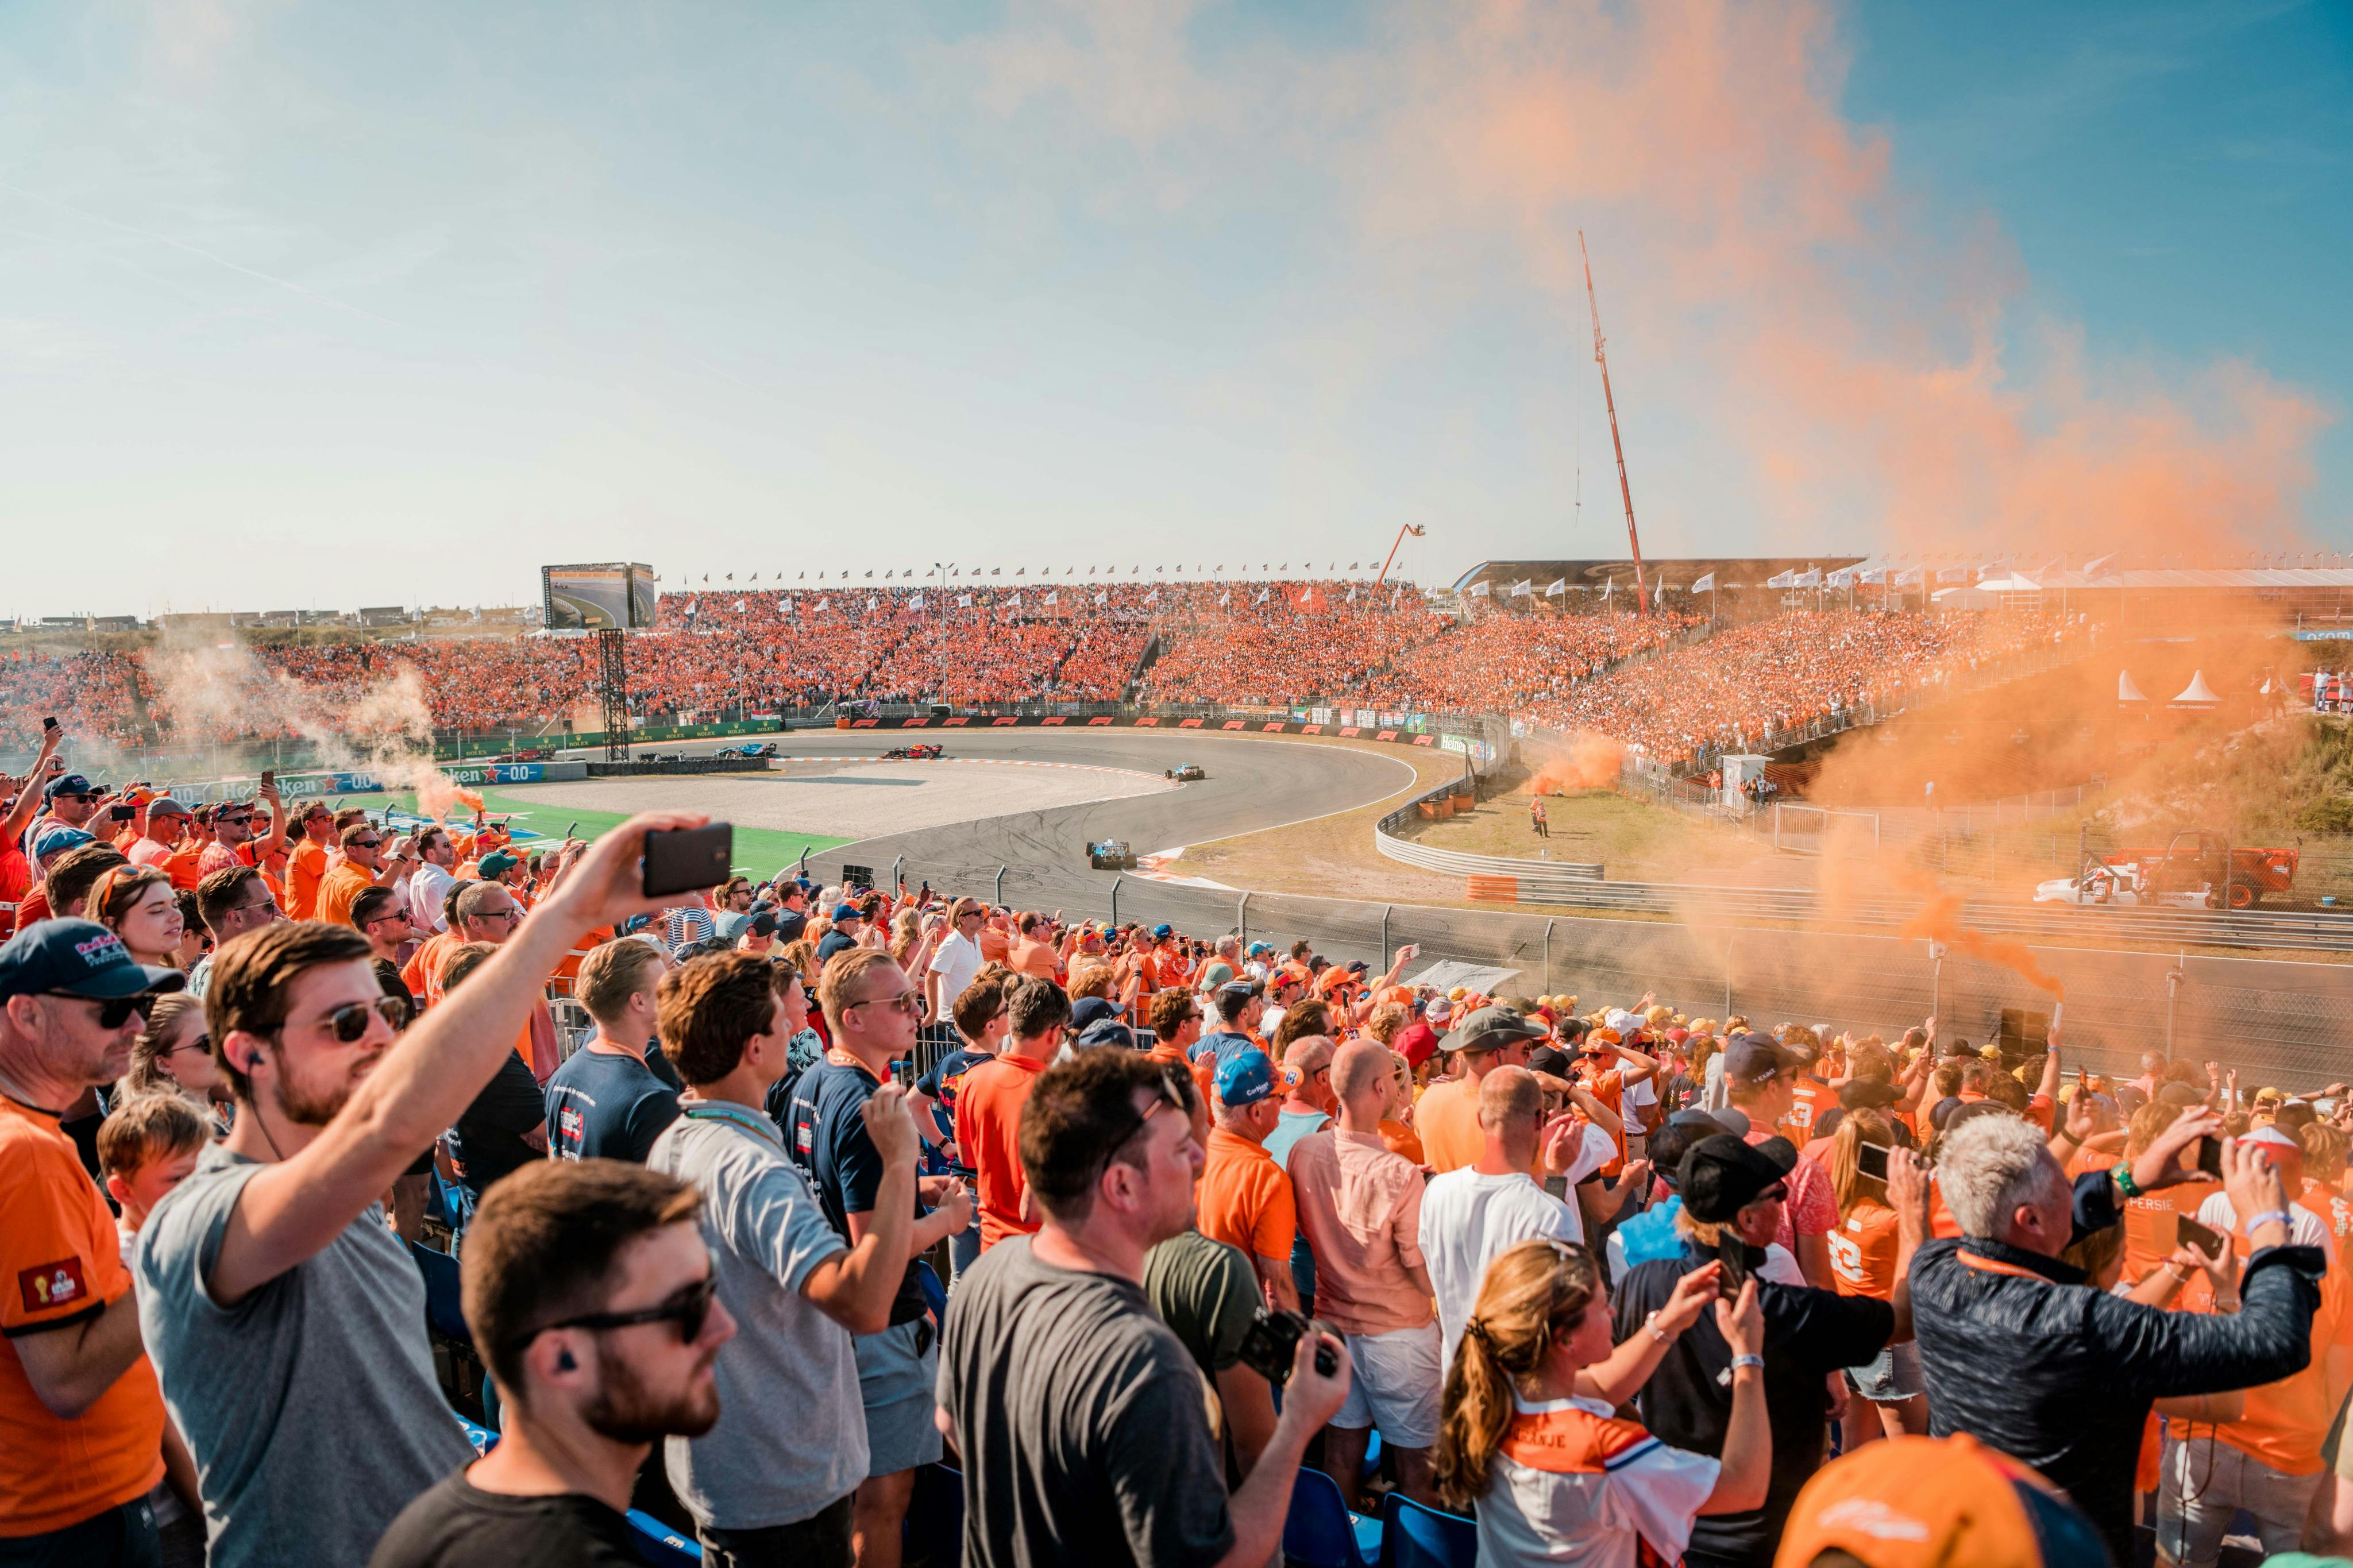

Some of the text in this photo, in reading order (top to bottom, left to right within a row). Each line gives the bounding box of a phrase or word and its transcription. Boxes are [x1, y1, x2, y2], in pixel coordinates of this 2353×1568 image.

[2306, 632, 2353, 640] aram
[851, 719, 880, 727] F1
[902, 718, 929, 727] F1
[942, 717, 970, 726] F1
[992, 717, 1019, 725] F1
[1040, 717, 1067, 725] F1
[1088, 717, 1114, 725] F1
[1134, 718, 1159, 726] F1
[1179, 719, 1204, 728] F1
[1222, 721, 1246, 730] F1
[1263, 722, 1286, 732] F1
[1301, 724, 1323, 735] F1
[1339, 727, 1361, 737] F1
[1376, 730, 1398, 741] F1
[1413, 735, 1434, 746] F1
[1441, 735, 1474, 755] Heinen
[510, 766, 529, 781] 0.0
[221, 774, 372, 800] Heiken 0.0
[1286, 1071, 1297, 1085] 33
[1246, 1082, 1269, 1096] CarNext
